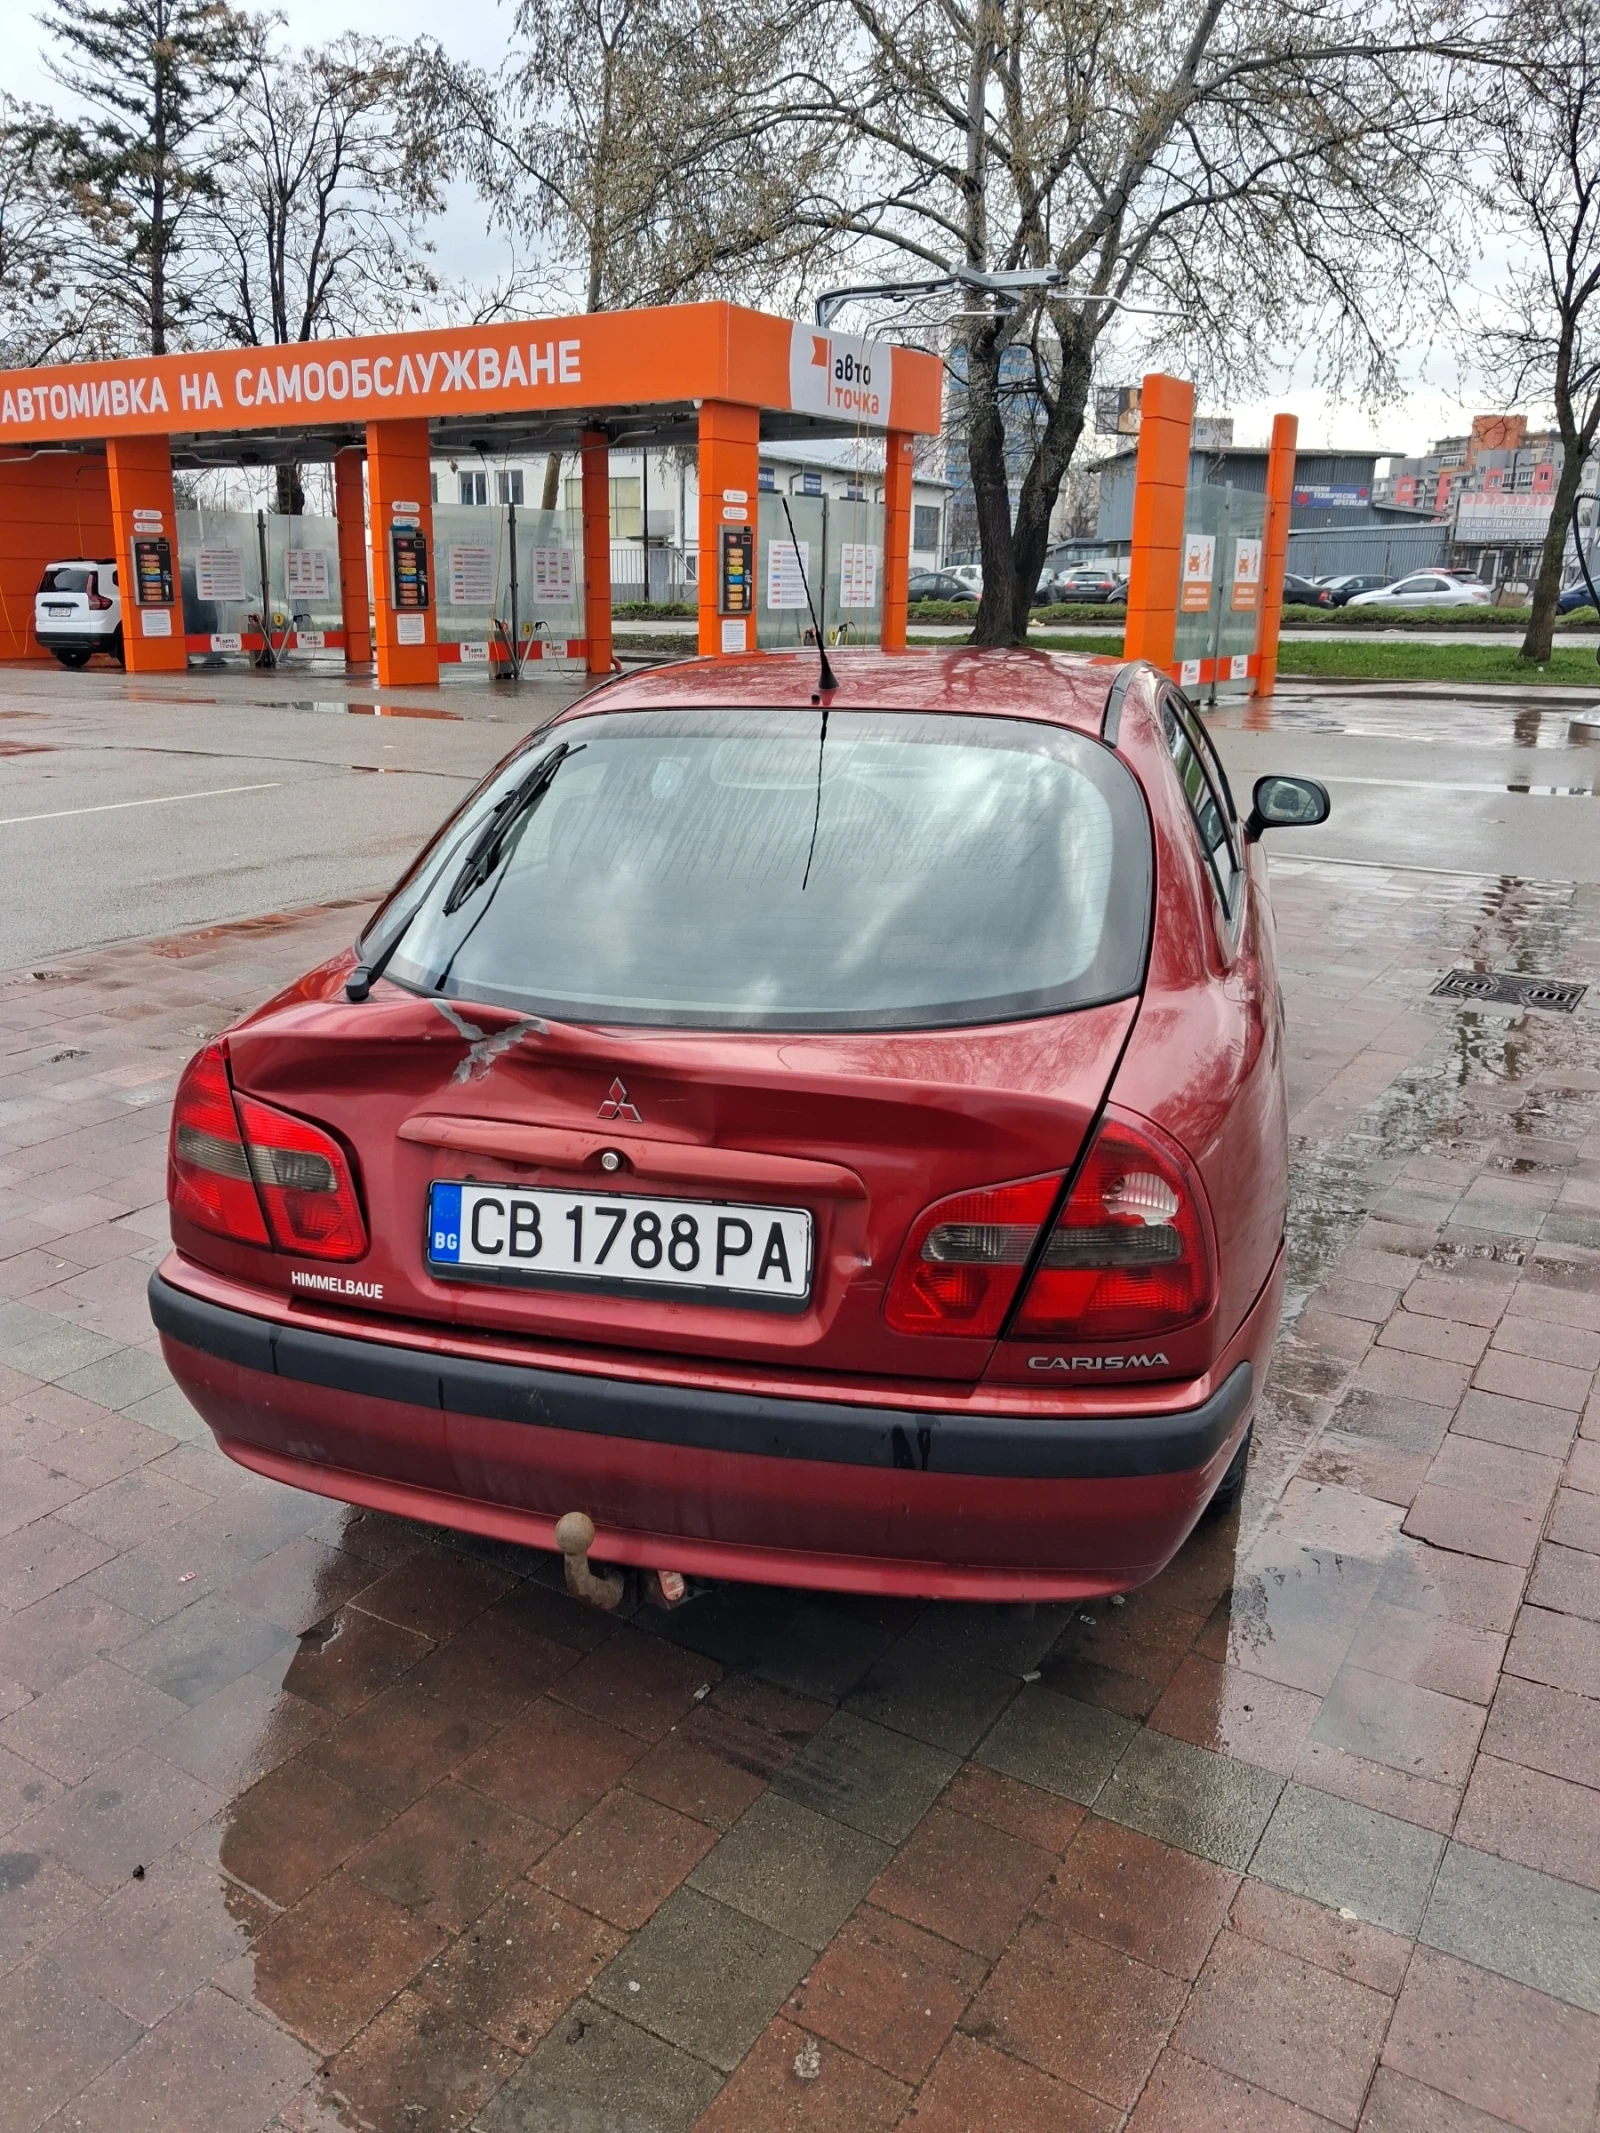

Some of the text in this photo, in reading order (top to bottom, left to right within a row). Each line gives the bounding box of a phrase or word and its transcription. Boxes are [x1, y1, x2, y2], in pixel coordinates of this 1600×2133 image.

[1, 339, 582, 424] АВТОМИВКА НА САМООБСЛУЖВАНЕ
[835, 353, 872, 386] авто
[835, 386, 880, 415] точка
[434, 1231, 458, 1252] BG
[470, 1195, 793, 1283] CB 1788 PA
[290, 1270, 384, 1300] HIMMELBAUE
[1028, 1352, 1170, 1371] CARISMA
